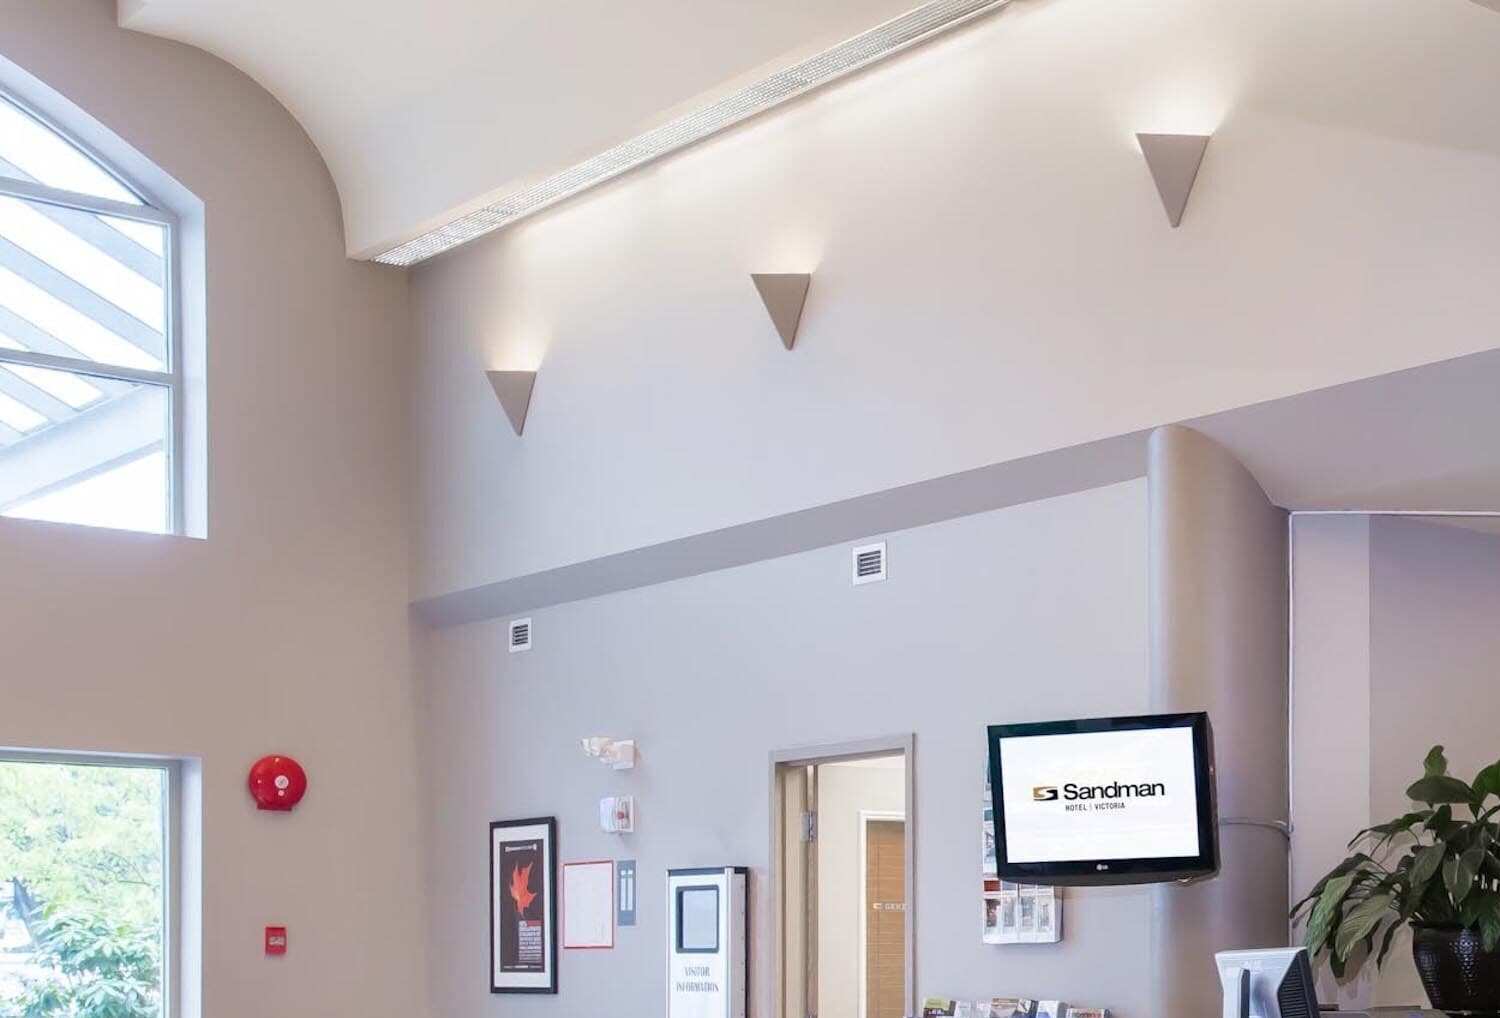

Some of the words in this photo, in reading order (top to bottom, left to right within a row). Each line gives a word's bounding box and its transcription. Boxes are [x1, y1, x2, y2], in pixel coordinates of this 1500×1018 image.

[1063, 781, 1166, 801] Sandman
[1065, 803, 1088, 812] HOTEL
[1095, 802, 1126, 811] VICTORIA
[684, 966, 710, 977] VISITOR
[676, 982, 719, 993] INFORMATION
